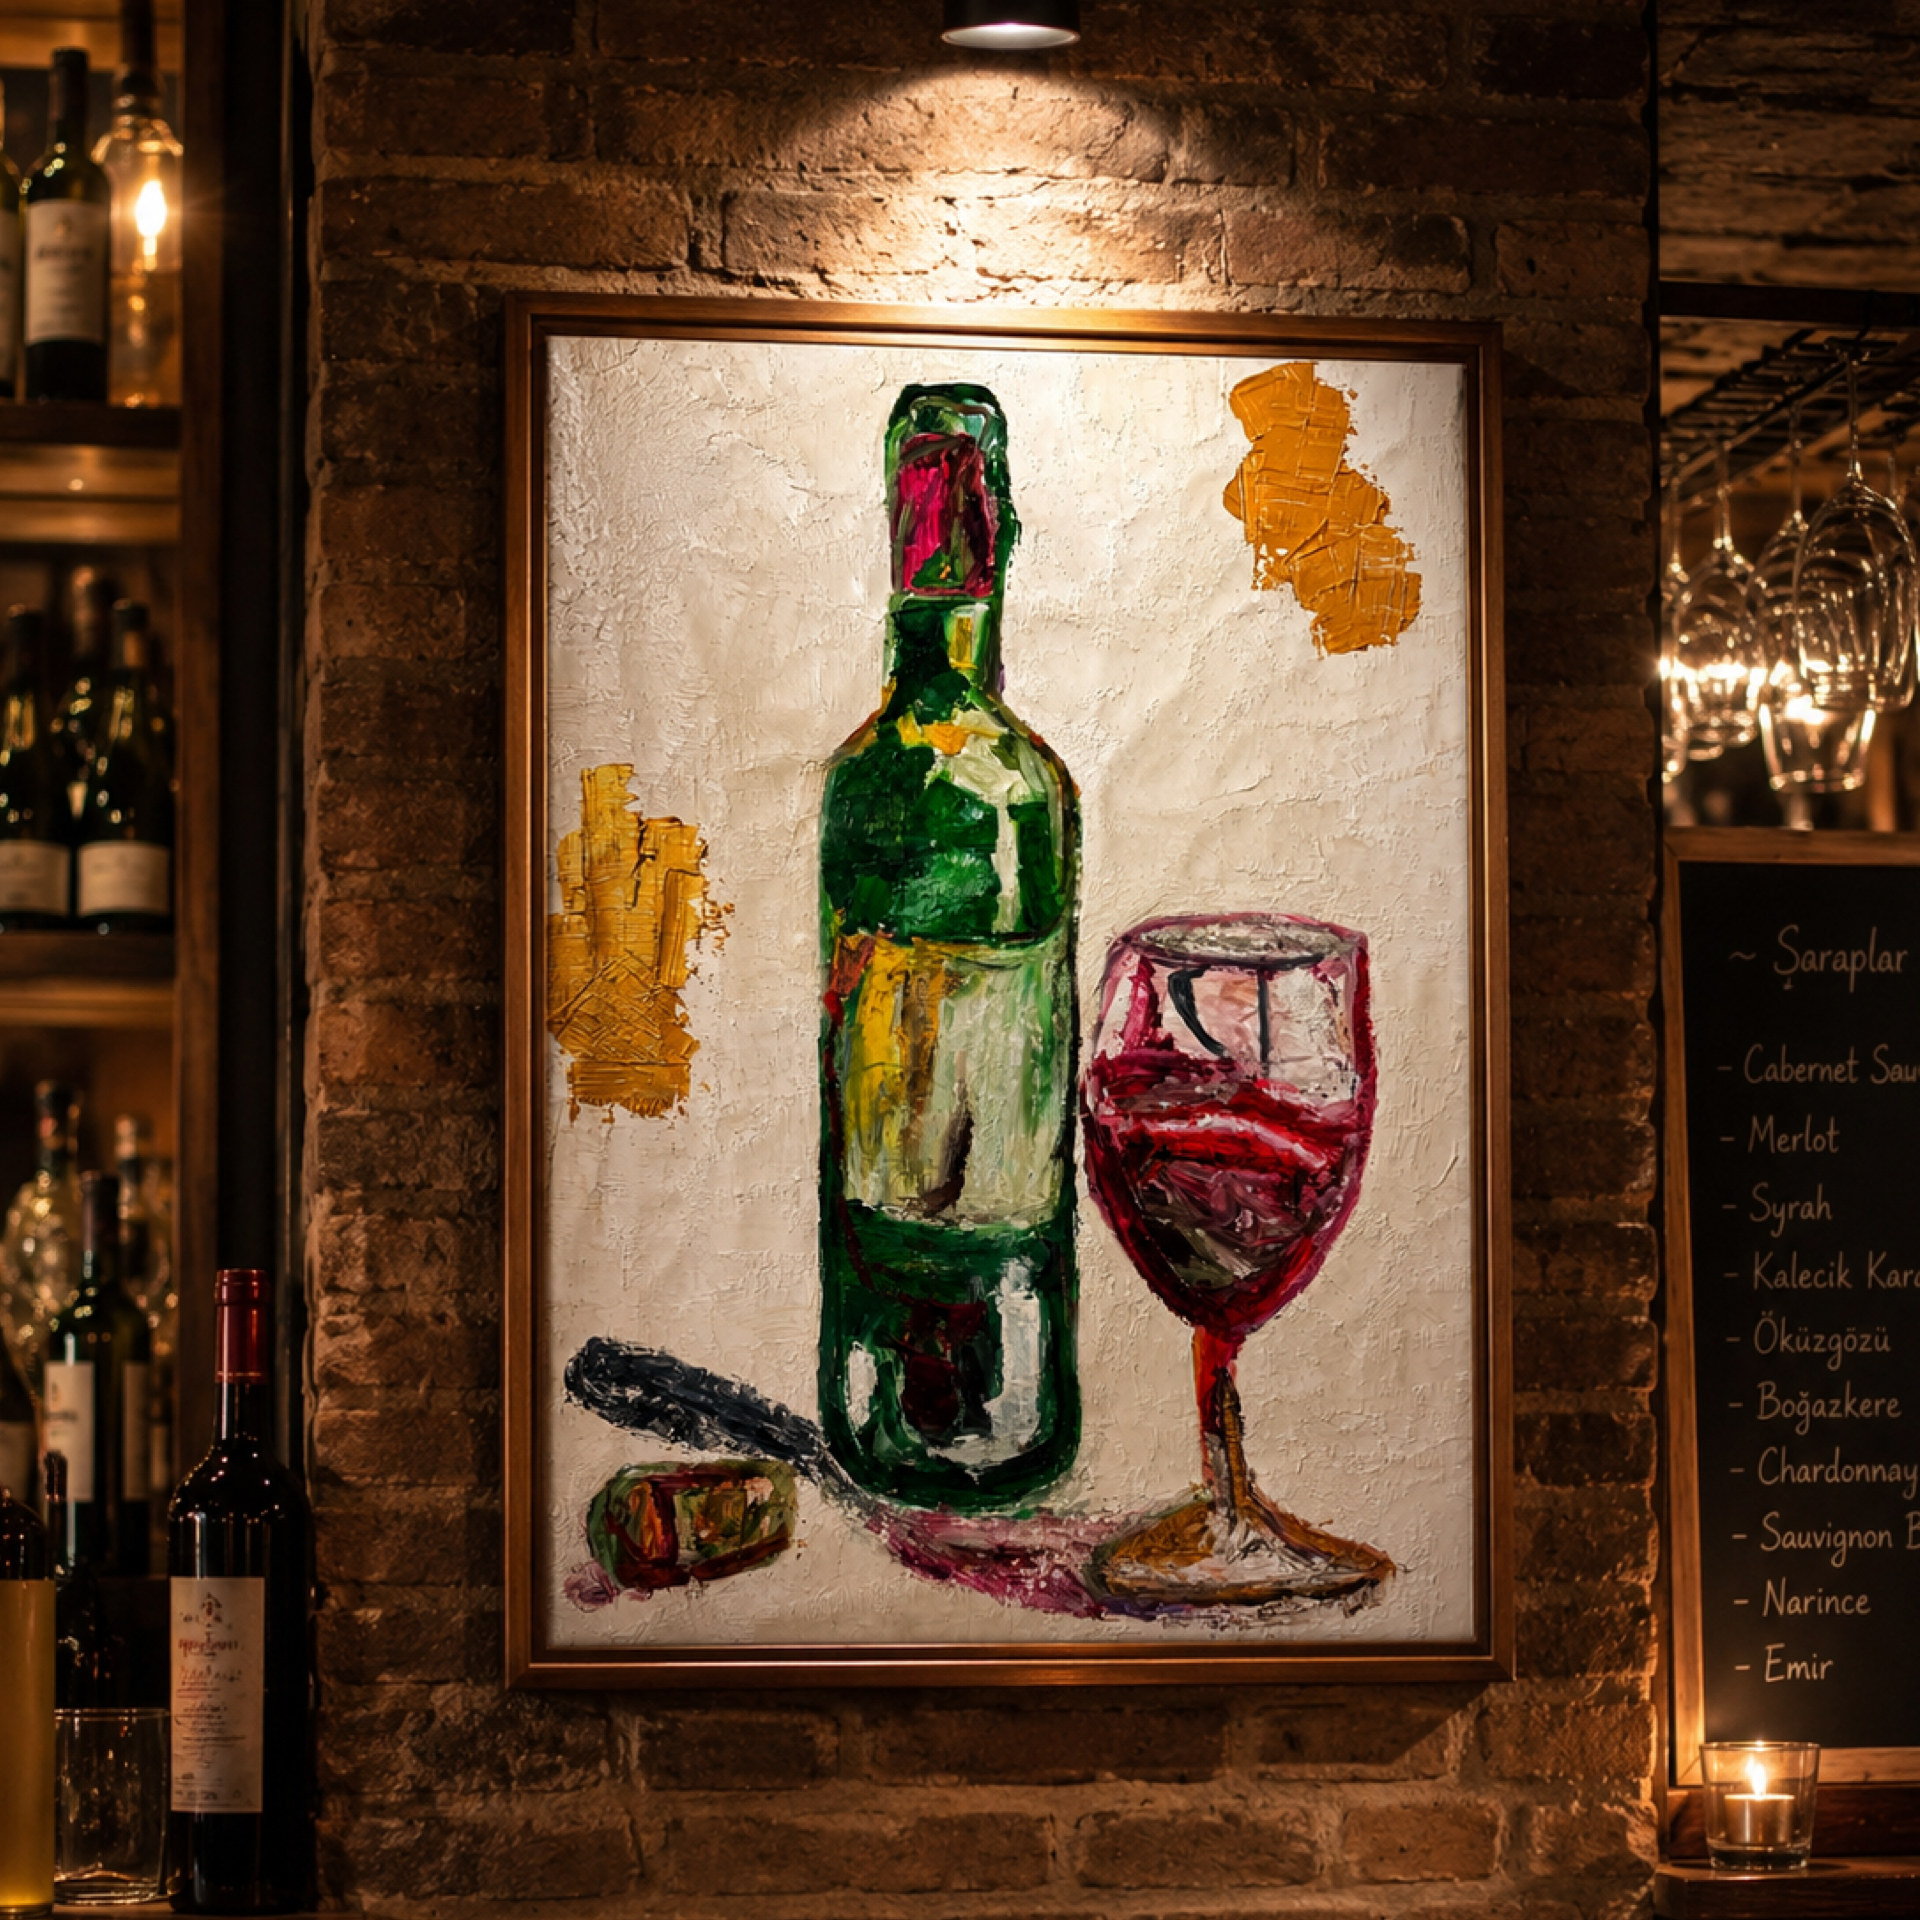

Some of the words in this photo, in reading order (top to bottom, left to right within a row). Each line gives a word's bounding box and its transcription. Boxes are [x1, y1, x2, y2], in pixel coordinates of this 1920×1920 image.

[1773, 924, 1909, 993] Şaraplar
[1744, 1043, 1860, 1084] Cabernet
[1869, 1043, 1920, 1085] Sau
[1748, 1114, 1840, 1154] Merlot
[1749, 1181, 1832, 1238] Syrah
[1753, 1250, 1853, 1290] Kalecik
[1753, 1310, 1891, 1372] Öküzgözü
[1756, 1380, 1902, 1436] Boğazkere
[1757, 1445, 1919, 1501] Chardonnay
[1759, 1510, 1894, 1569] Sauvignon
[1762, 1576, 1872, 1618] Narince
[1764, 1642, 1834, 1683] Emir
